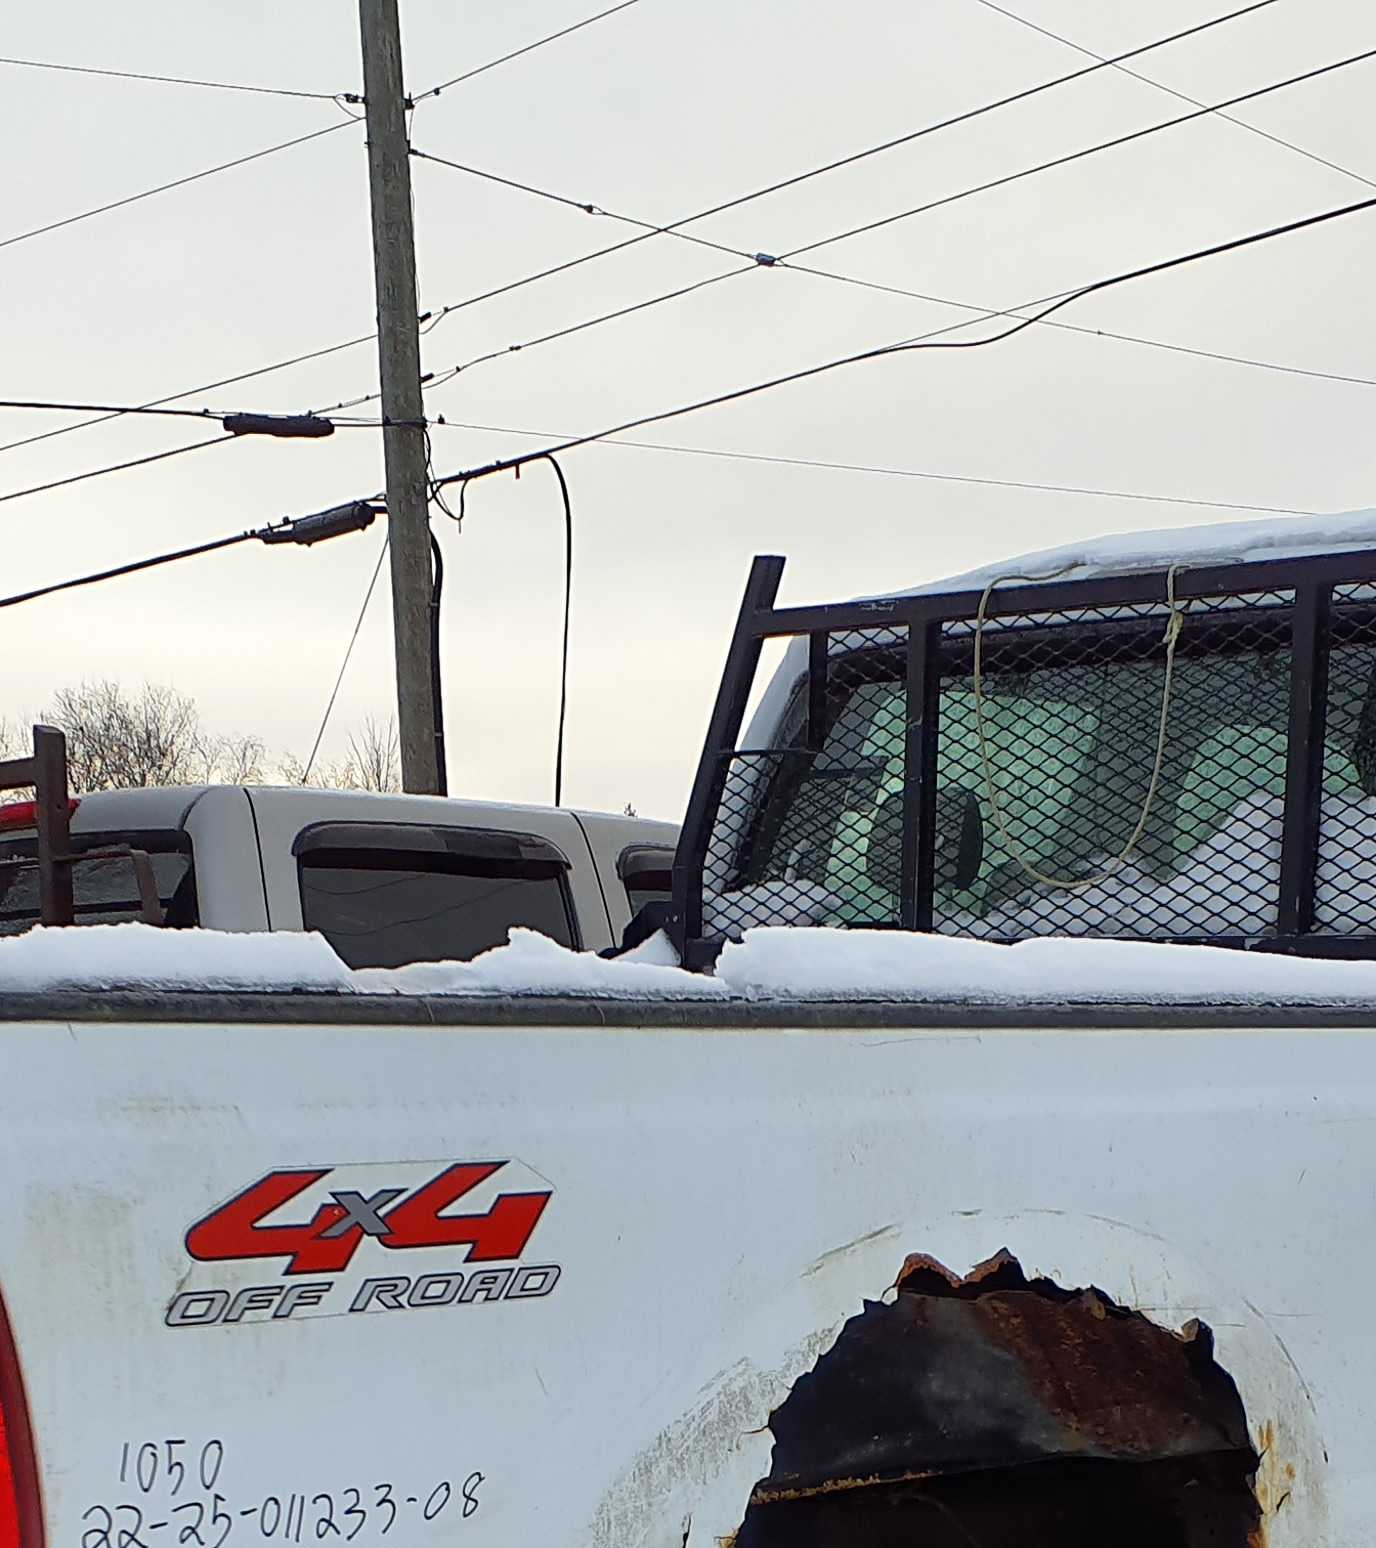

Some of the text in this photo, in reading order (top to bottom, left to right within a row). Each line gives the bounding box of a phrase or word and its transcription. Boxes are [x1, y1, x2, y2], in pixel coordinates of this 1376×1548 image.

[164, 1264, 563, 1328] OFF ROAD
[119, 1439, 225, 1496] 1050
